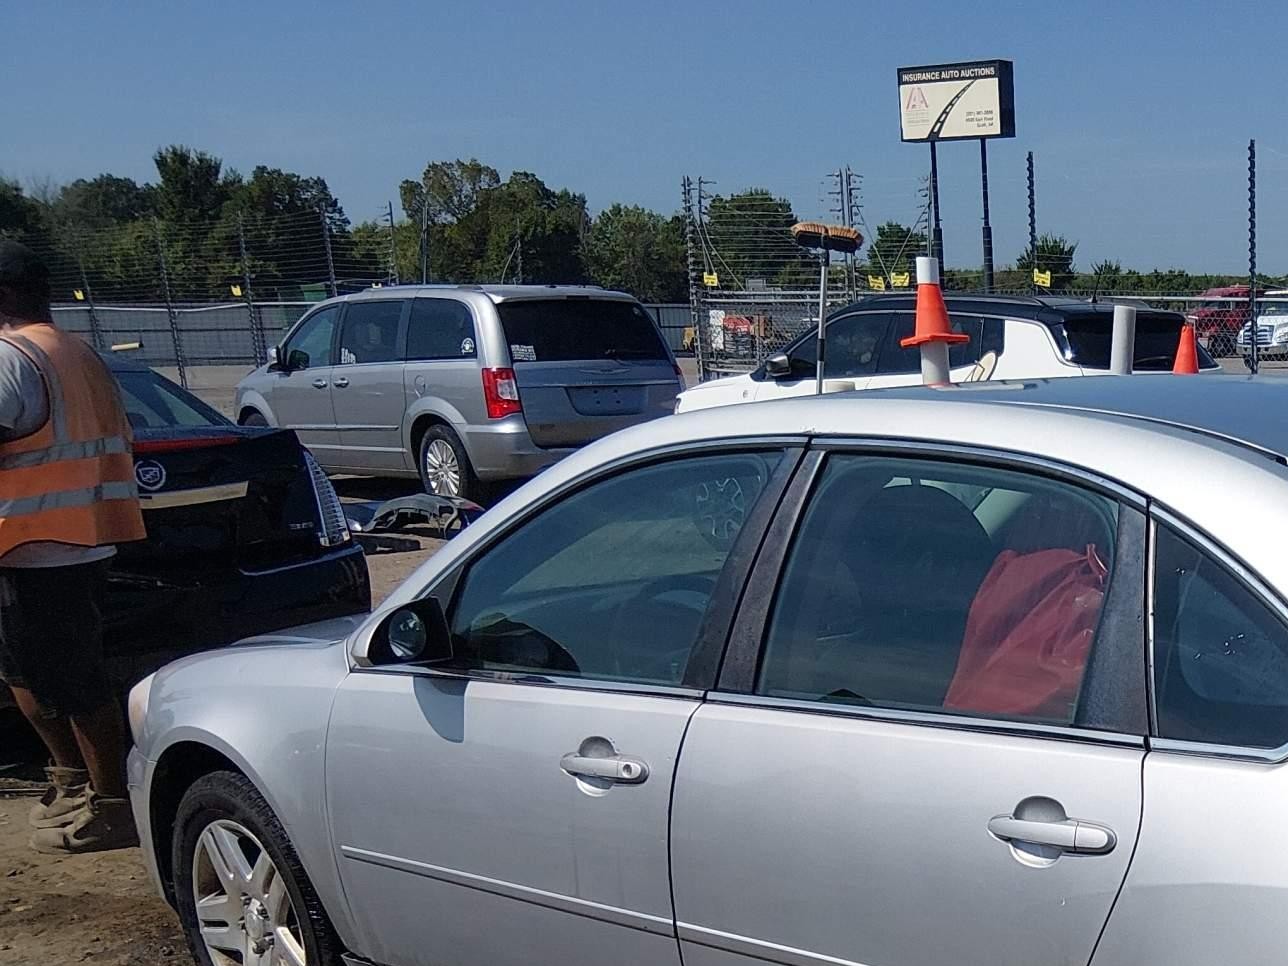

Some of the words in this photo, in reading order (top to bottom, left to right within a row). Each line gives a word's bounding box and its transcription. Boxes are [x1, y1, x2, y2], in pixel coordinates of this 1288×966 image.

[902, 71, 940, 82] INSURANCE
[941, 70, 960, 79] AUTO
[961, 66, 995, 78] AUCTIONS
